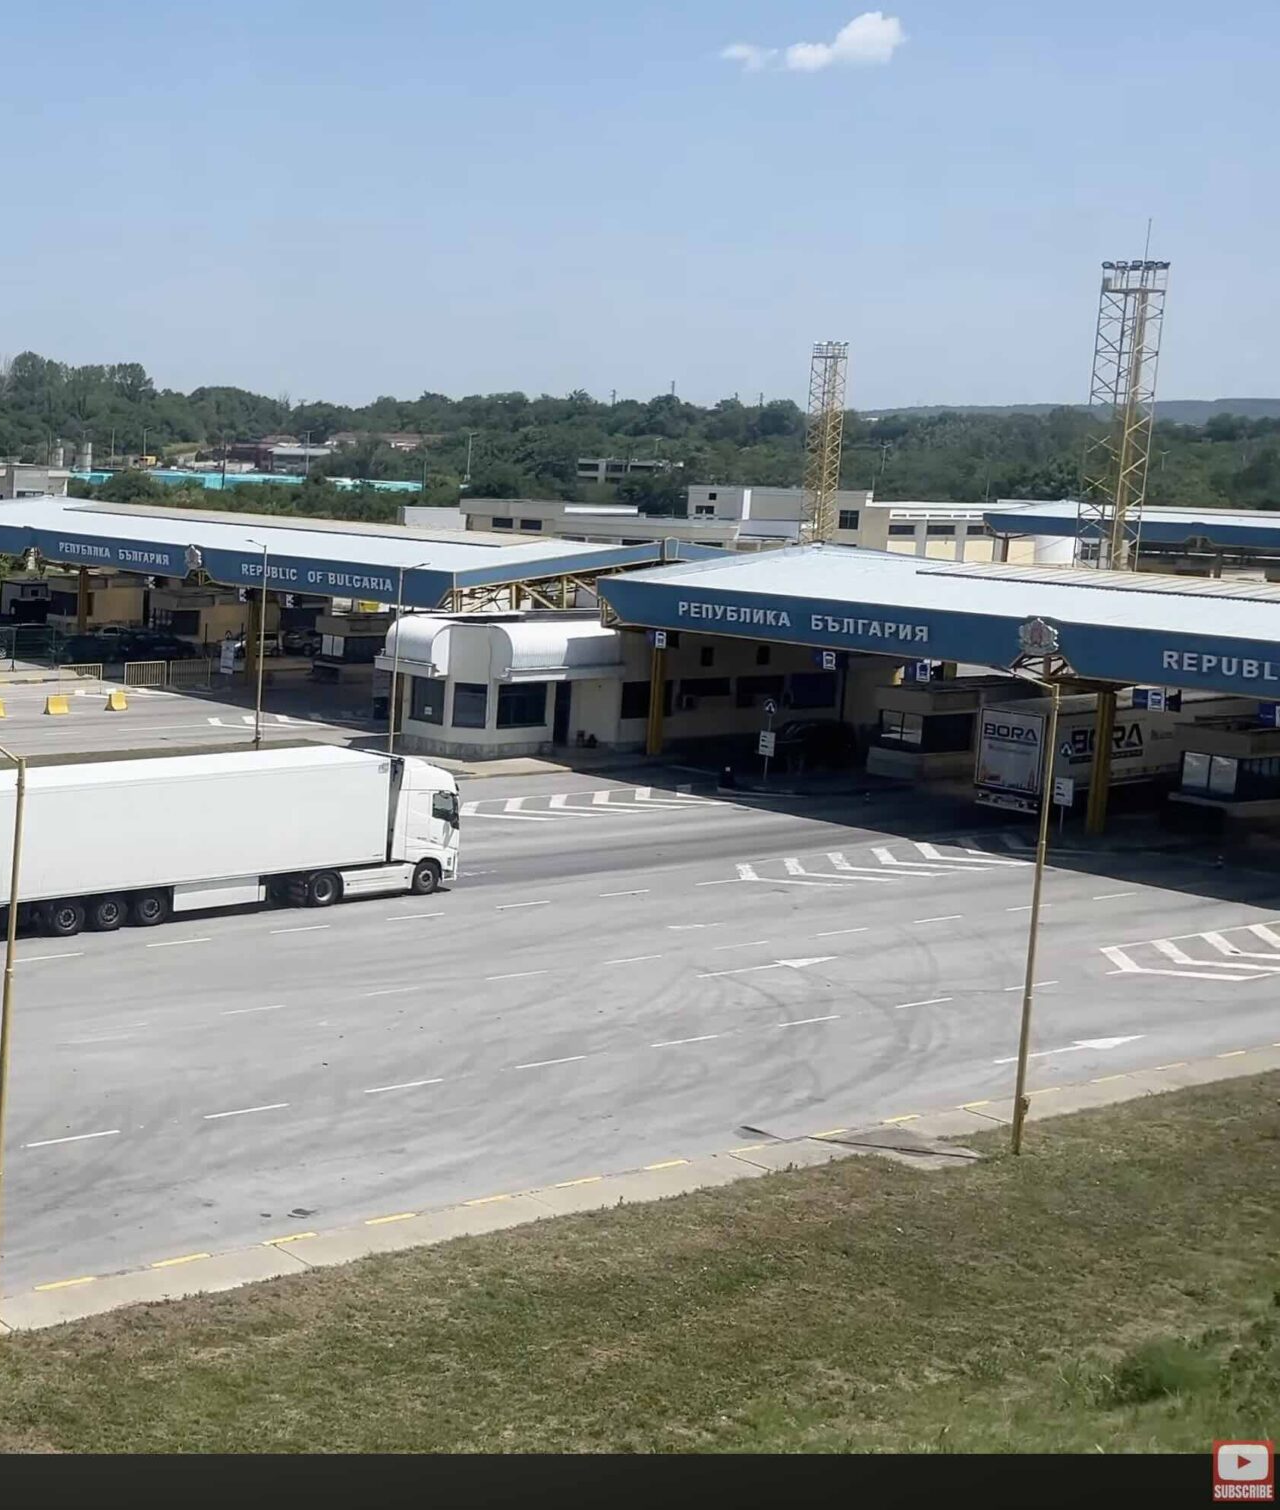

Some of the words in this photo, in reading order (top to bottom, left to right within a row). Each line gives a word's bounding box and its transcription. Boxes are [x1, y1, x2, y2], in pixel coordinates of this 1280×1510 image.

[118, 549, 170, 566] БЪЛГАРИЯ
[241, 563, 297, 581] REPUBLIC
[307, 571, 323, 584] OF
[328, 572, 393, 592] BULGARIA
[678, 602, 791, 627] РЕПУБЛИКА
[811, 614, 929, 643] БЪЛГАРИЯ
[1163, 650, 1278, 681] REPUBL
[984, 723, 1038, 742] BORA
[1071, 723, 1143, 754] BRA
